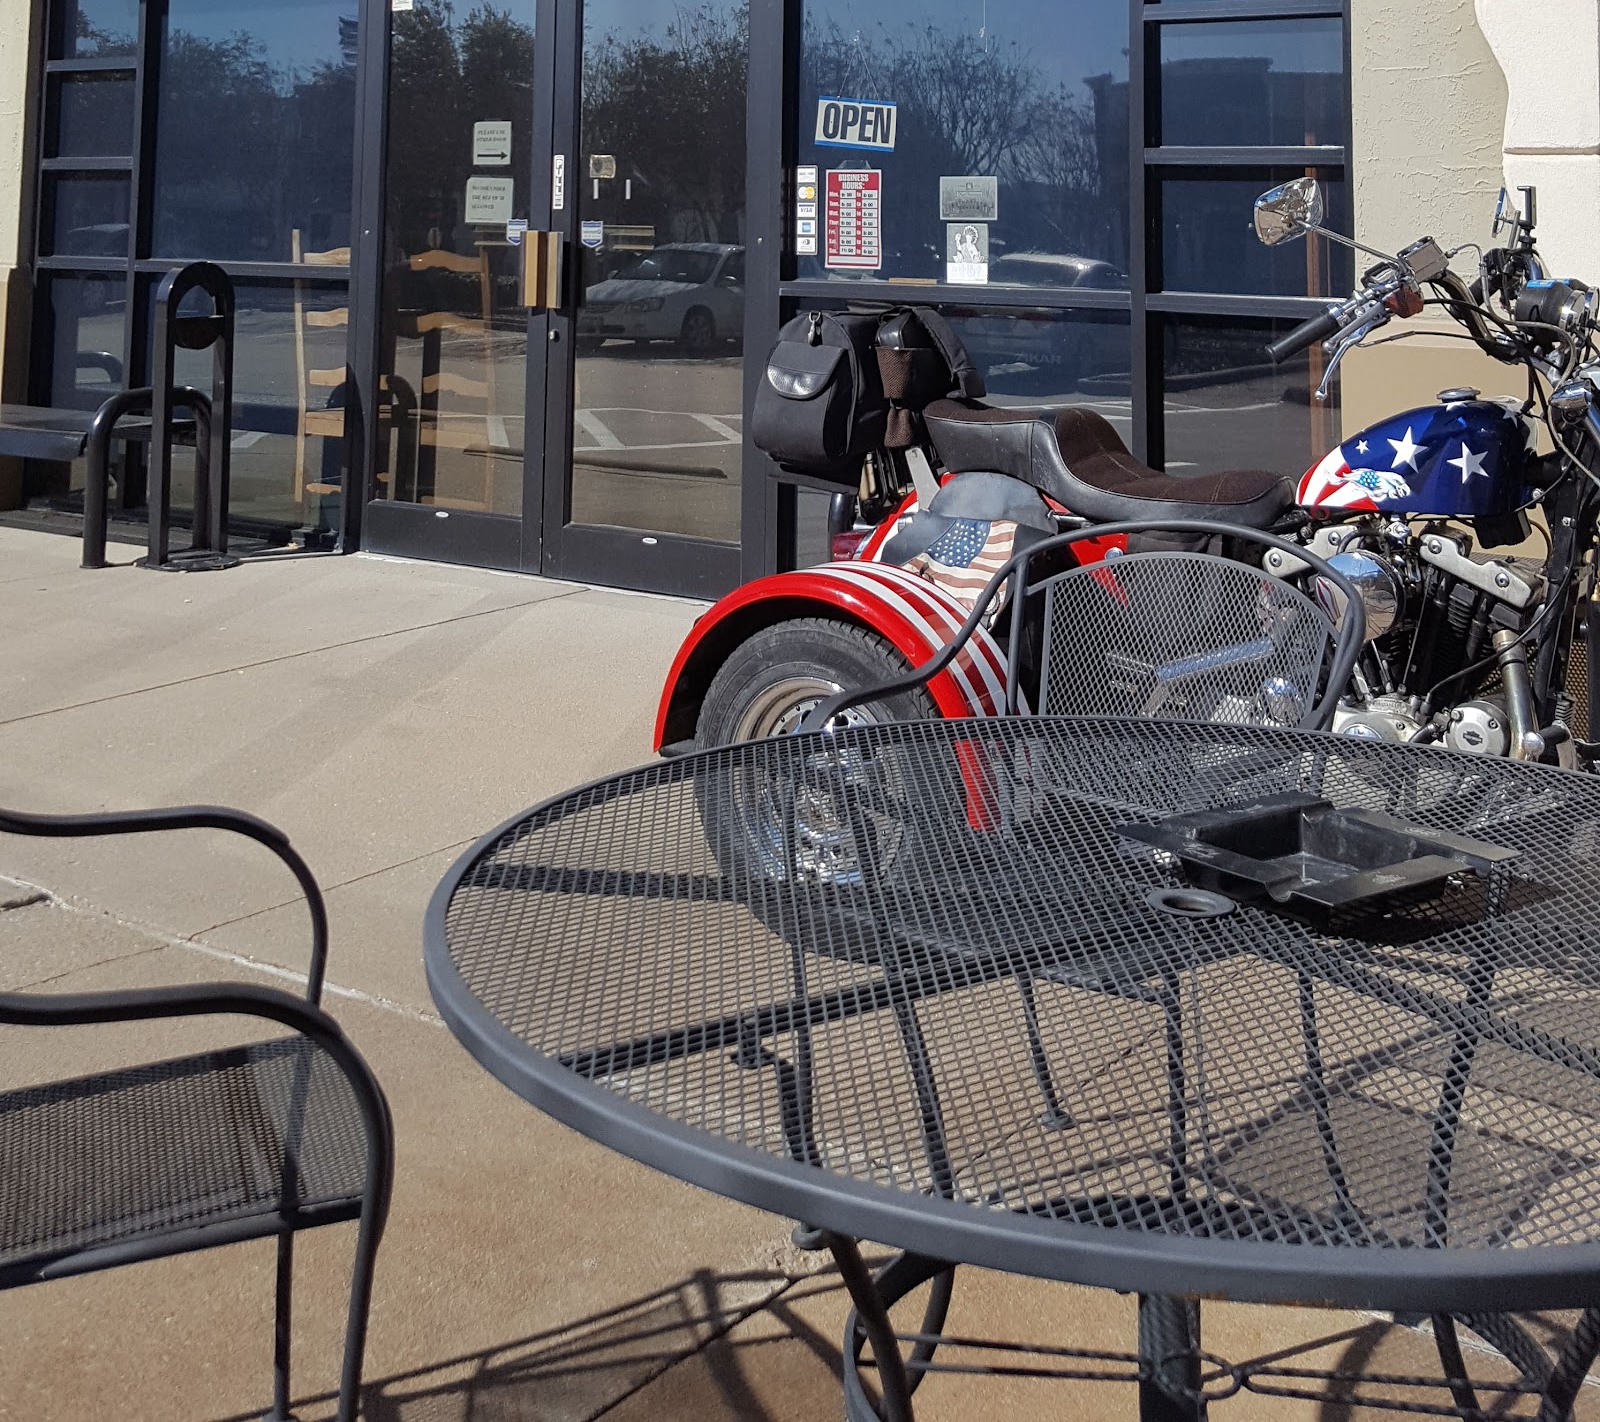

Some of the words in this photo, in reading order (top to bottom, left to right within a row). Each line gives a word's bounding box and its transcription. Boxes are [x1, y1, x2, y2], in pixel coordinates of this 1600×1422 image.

[822, 102, 892, 144] OPEN
[838, 173, 869, 182] BUSINESS
[842, 182, 866, 190] HOURS:
